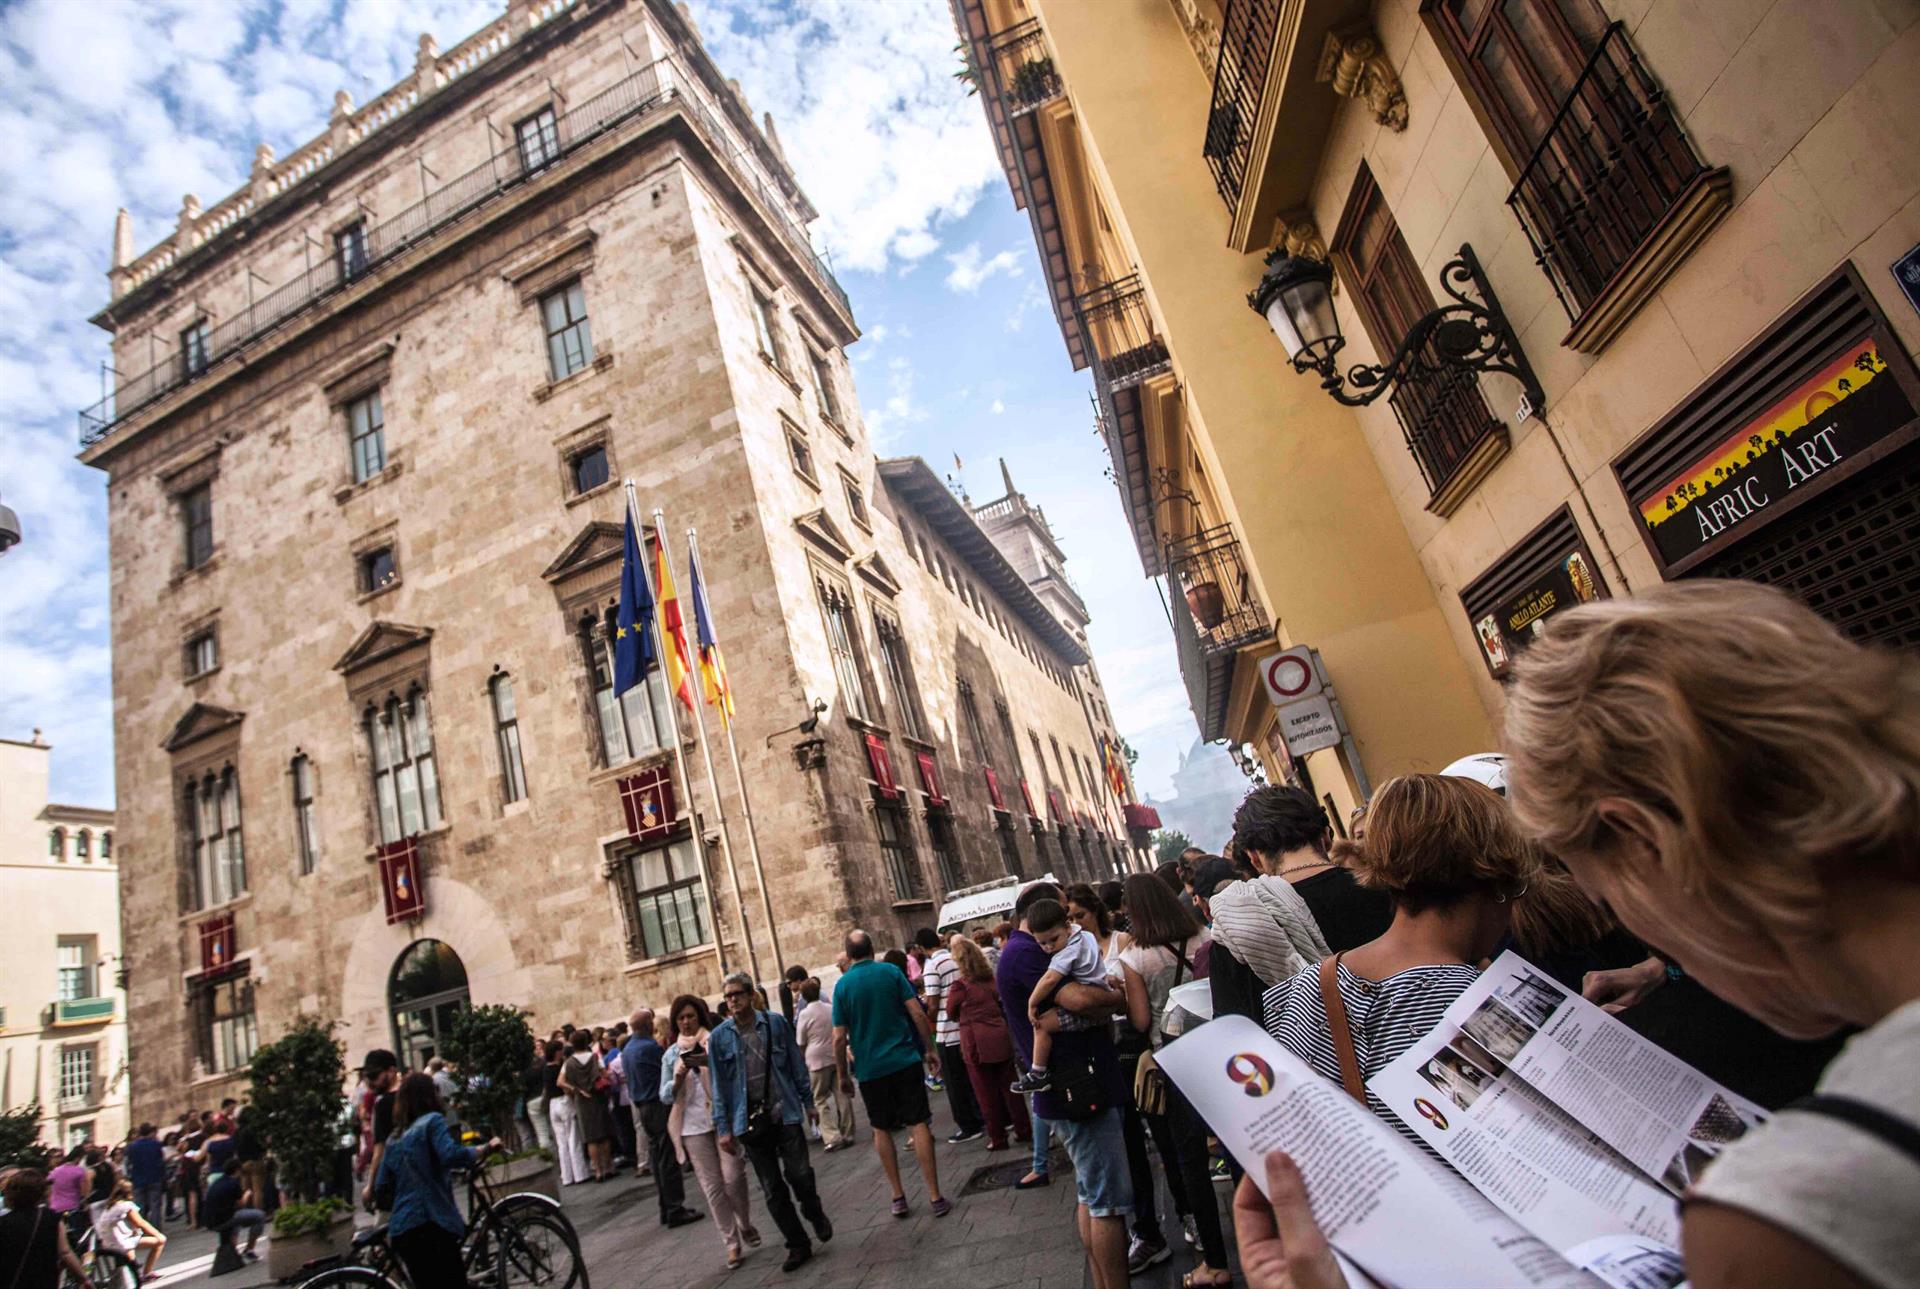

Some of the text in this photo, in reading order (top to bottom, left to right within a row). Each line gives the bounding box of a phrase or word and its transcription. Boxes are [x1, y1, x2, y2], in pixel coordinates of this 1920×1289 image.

[1694, 476, 1769, 542] AFRIC
[1528, 590, 1556, 616] ATLANTE
[1291, 712, 1320, 725] EXCEPTO
[1289, 725, 1332, 743] AUTORIZADOS
